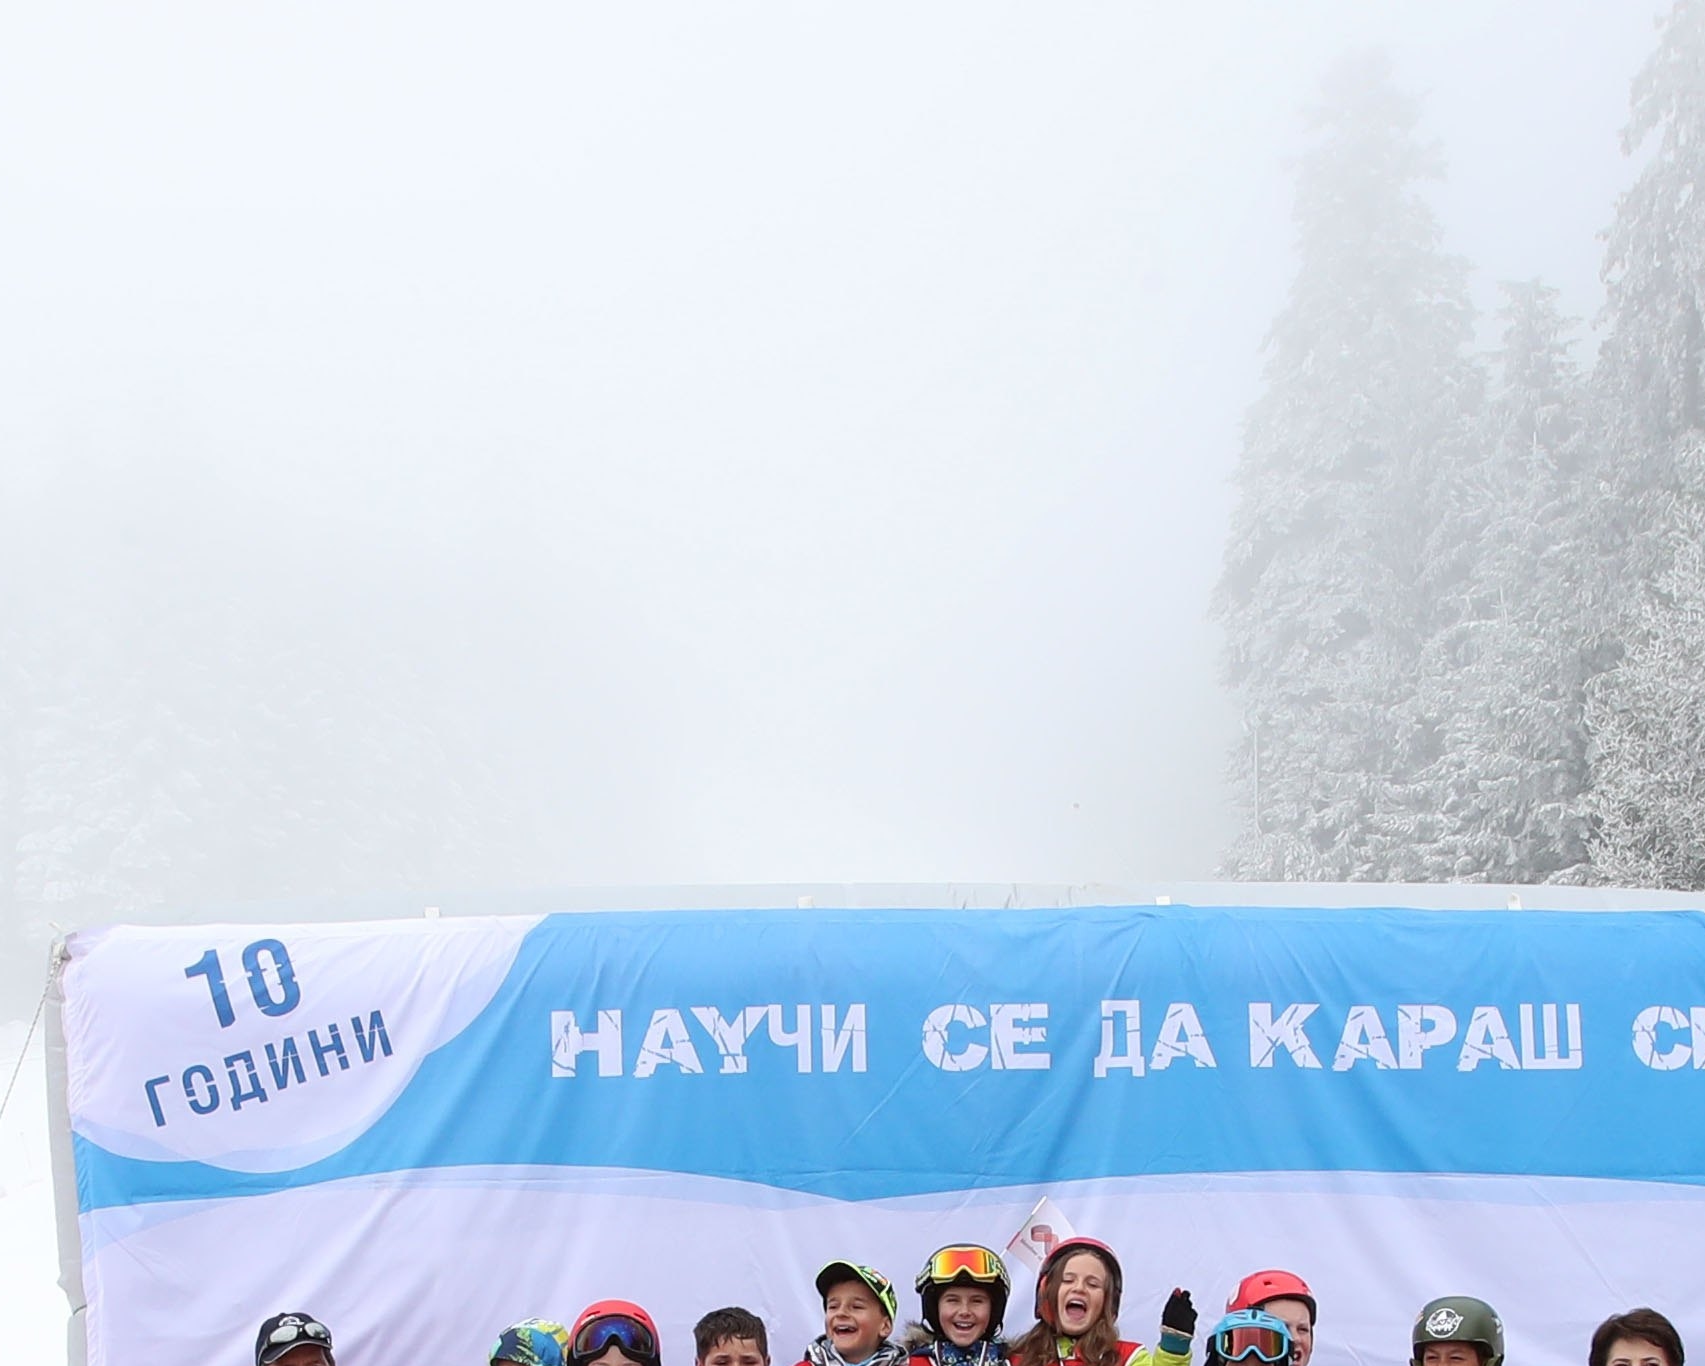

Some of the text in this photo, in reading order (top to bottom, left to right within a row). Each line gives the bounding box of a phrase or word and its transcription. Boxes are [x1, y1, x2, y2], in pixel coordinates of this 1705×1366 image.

[184, 938, 301, 1029] 10
[143, 1009, 395, 1128] ГОДИНИ
[550, 1003, 868, 1079] НАУЧИ
[922, 1004, 1052, 1072] СЕ
[1094, 999, 1217, 1078] ДА
[1248, 1003, 1584, 1073] КАРАШ
